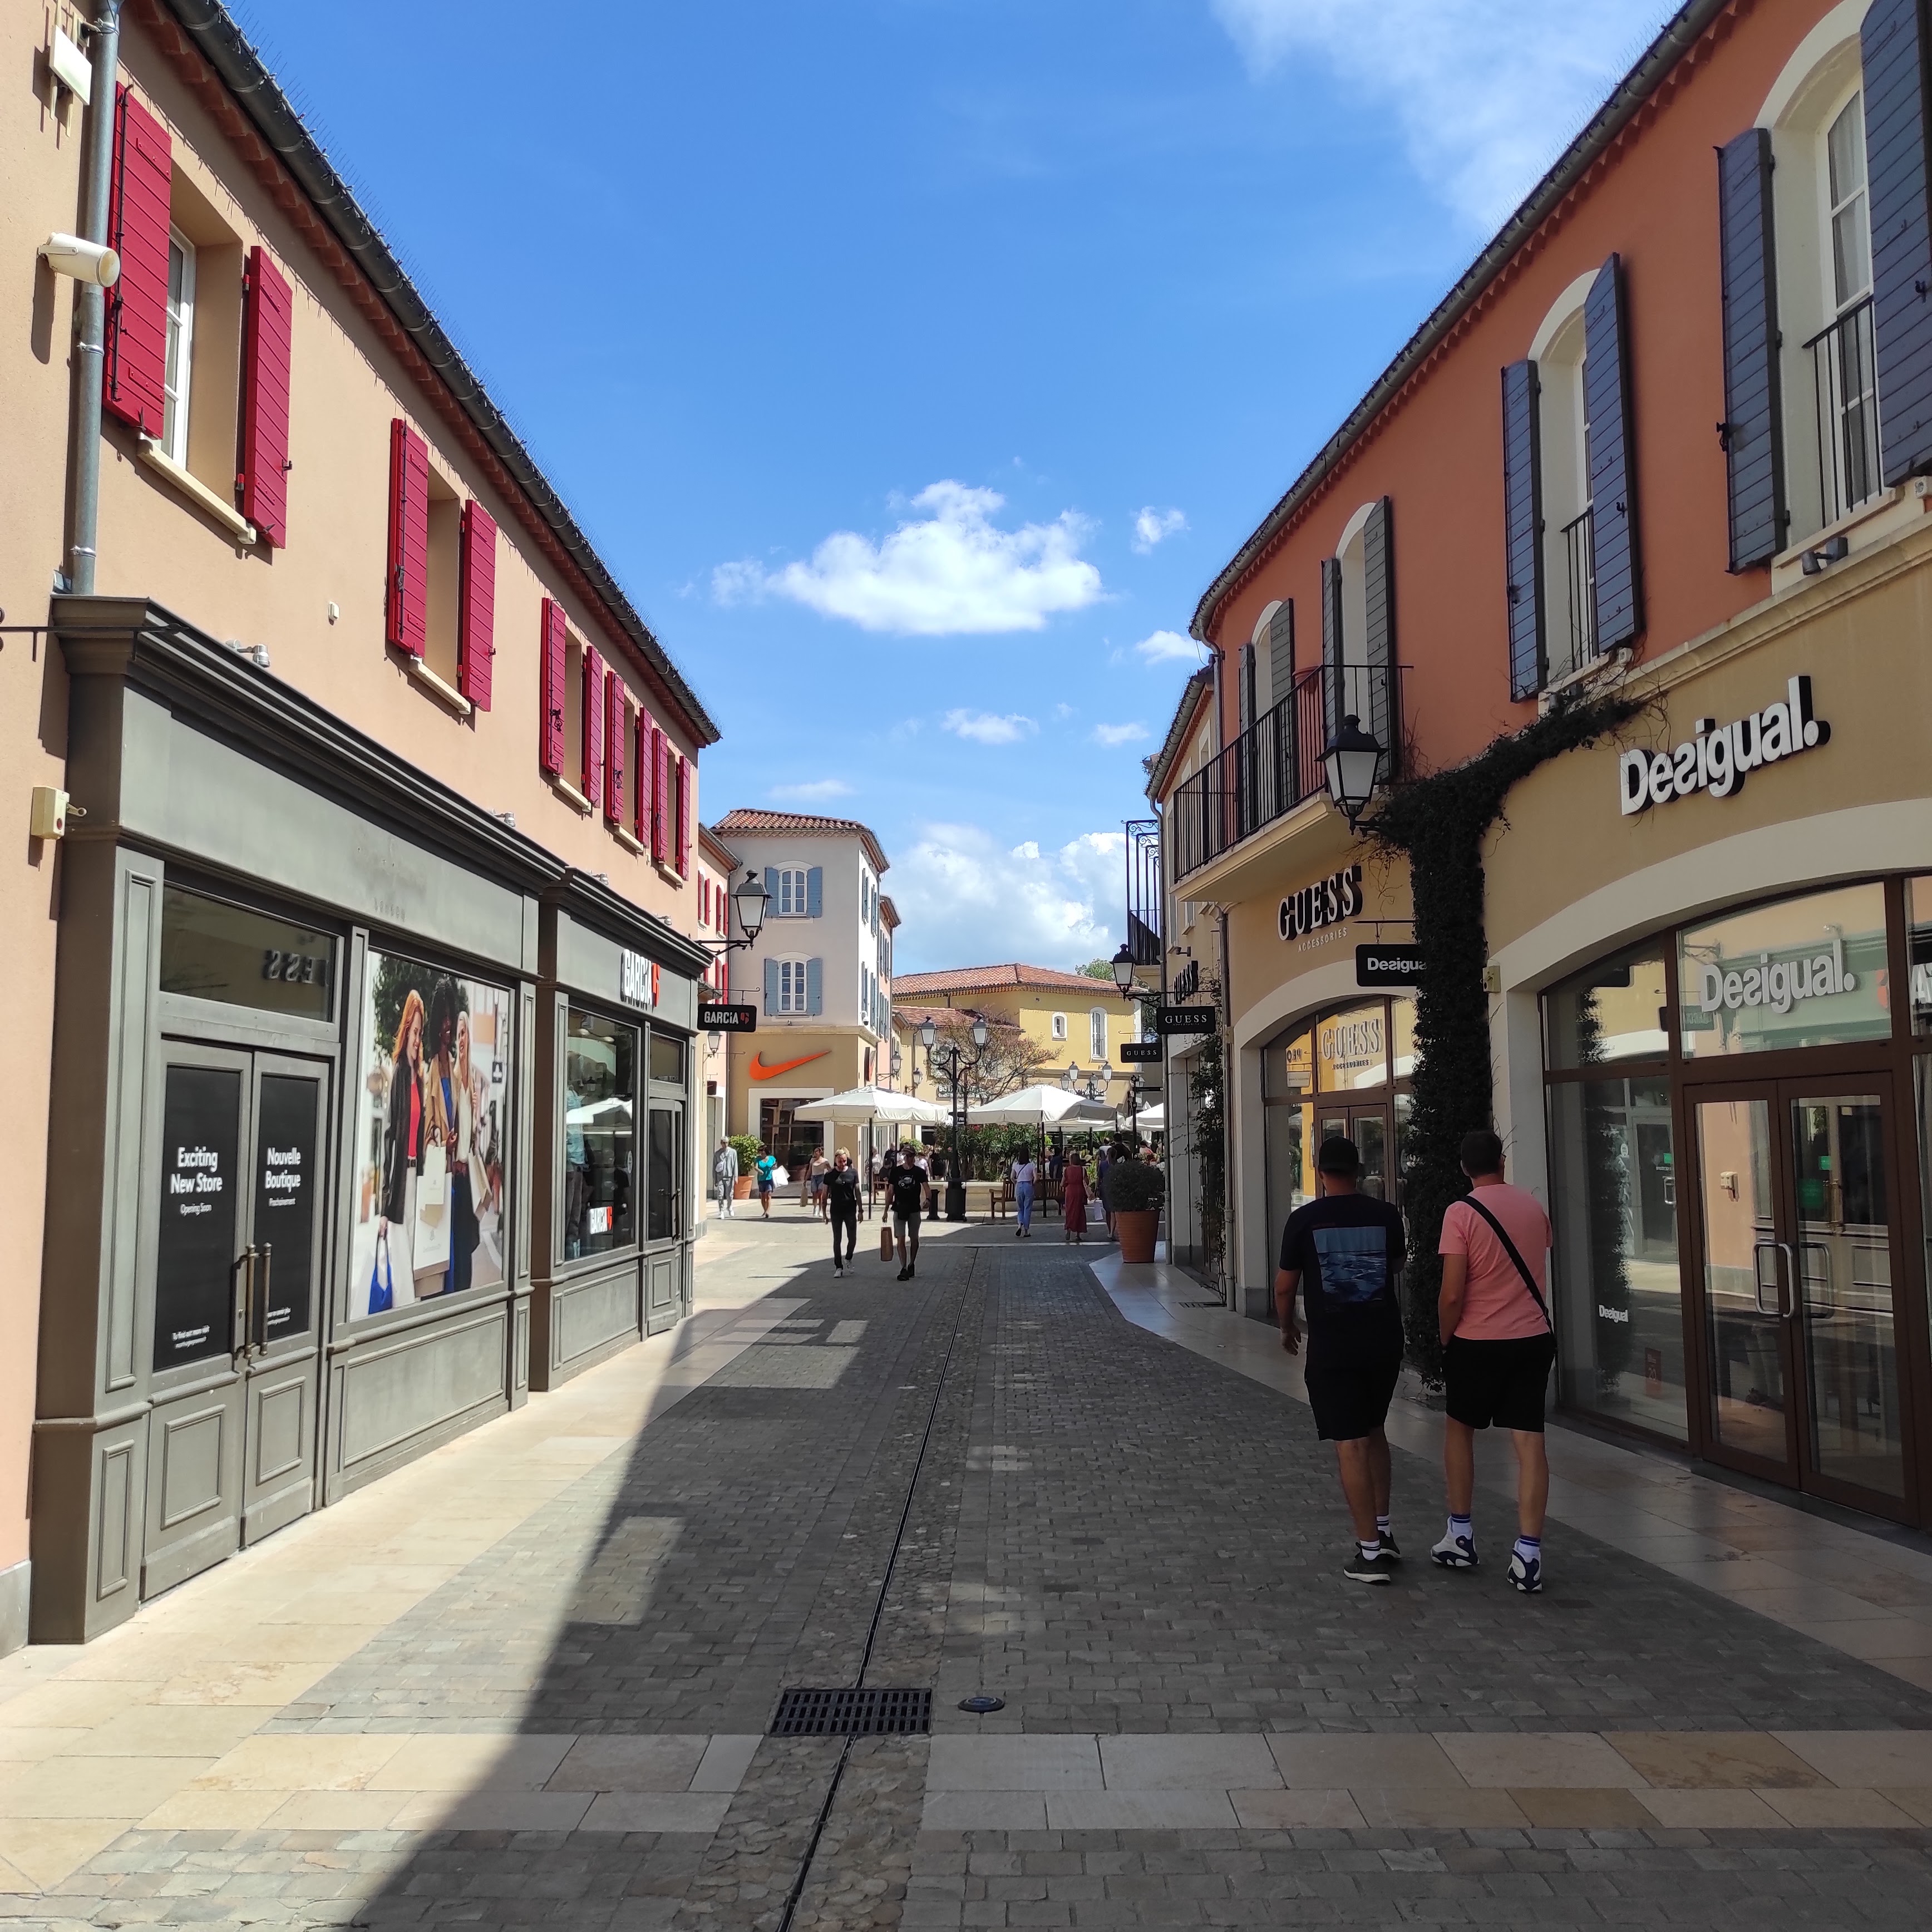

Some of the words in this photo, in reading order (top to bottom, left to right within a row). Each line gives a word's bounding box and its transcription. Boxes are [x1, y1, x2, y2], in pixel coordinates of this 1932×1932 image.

[1278, 866, 1363, 940] GUESS
[1298, 926, 1347, 953] ACCESSORIES
[1165, 1014, 1207, 1023] GUESS
[1322, 1019, 1383, 1060] GUESS
[178, 1146, 218, 1172] Exciting
[267, 1147, 300, 1165] Nouvelle
[170, 1173, 195, 1194] New
[196, 1172, 223, 1192] Store
[265, 1169, 301, 1193] Boutique
[1599, 1304, 1629, 1323] Desigual
